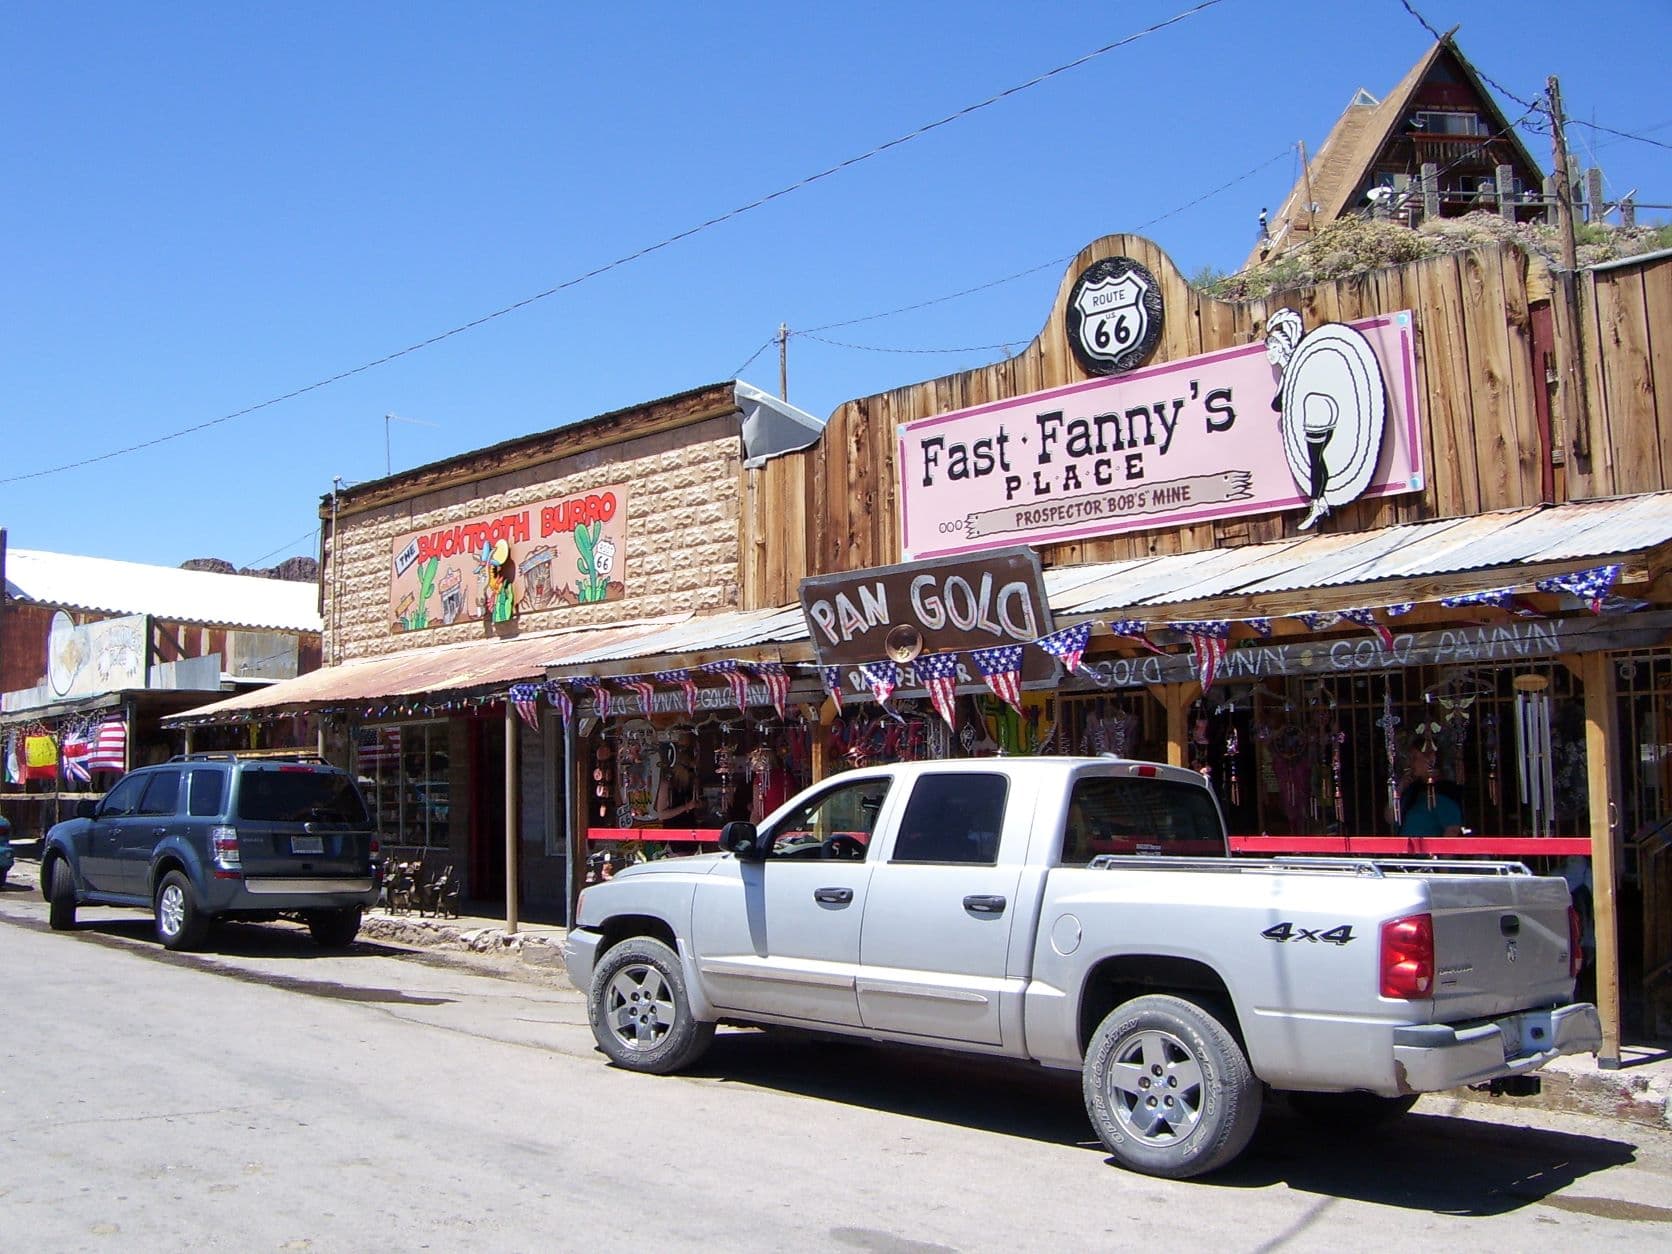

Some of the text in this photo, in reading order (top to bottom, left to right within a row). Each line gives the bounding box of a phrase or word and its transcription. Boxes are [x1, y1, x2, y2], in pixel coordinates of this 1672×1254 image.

[1092, 289, 1126, 307] ROUTE
[1095, 314, 1130, 349] 66
[921, 380, 1237, 487] Fast Fanny's
[1006, 453, 1144, 500] PLACE
[1016, 504, 1103, 527] PROSPECTOR
[1152, 485, 1191, 506] MINE
[417, 491, 616, 564] BUCKTOOTH BURRO
[398, 545, 417, 567] THE
[597, 556, 609, 570] 66
[810, 571, 1039, 646] PAN GOLD
[1330, 634, 1412, 668] GOLD
[1095, 656, 1162, 687] GOLD
[1095, 1018, 1139, 1089] COUNTRY
